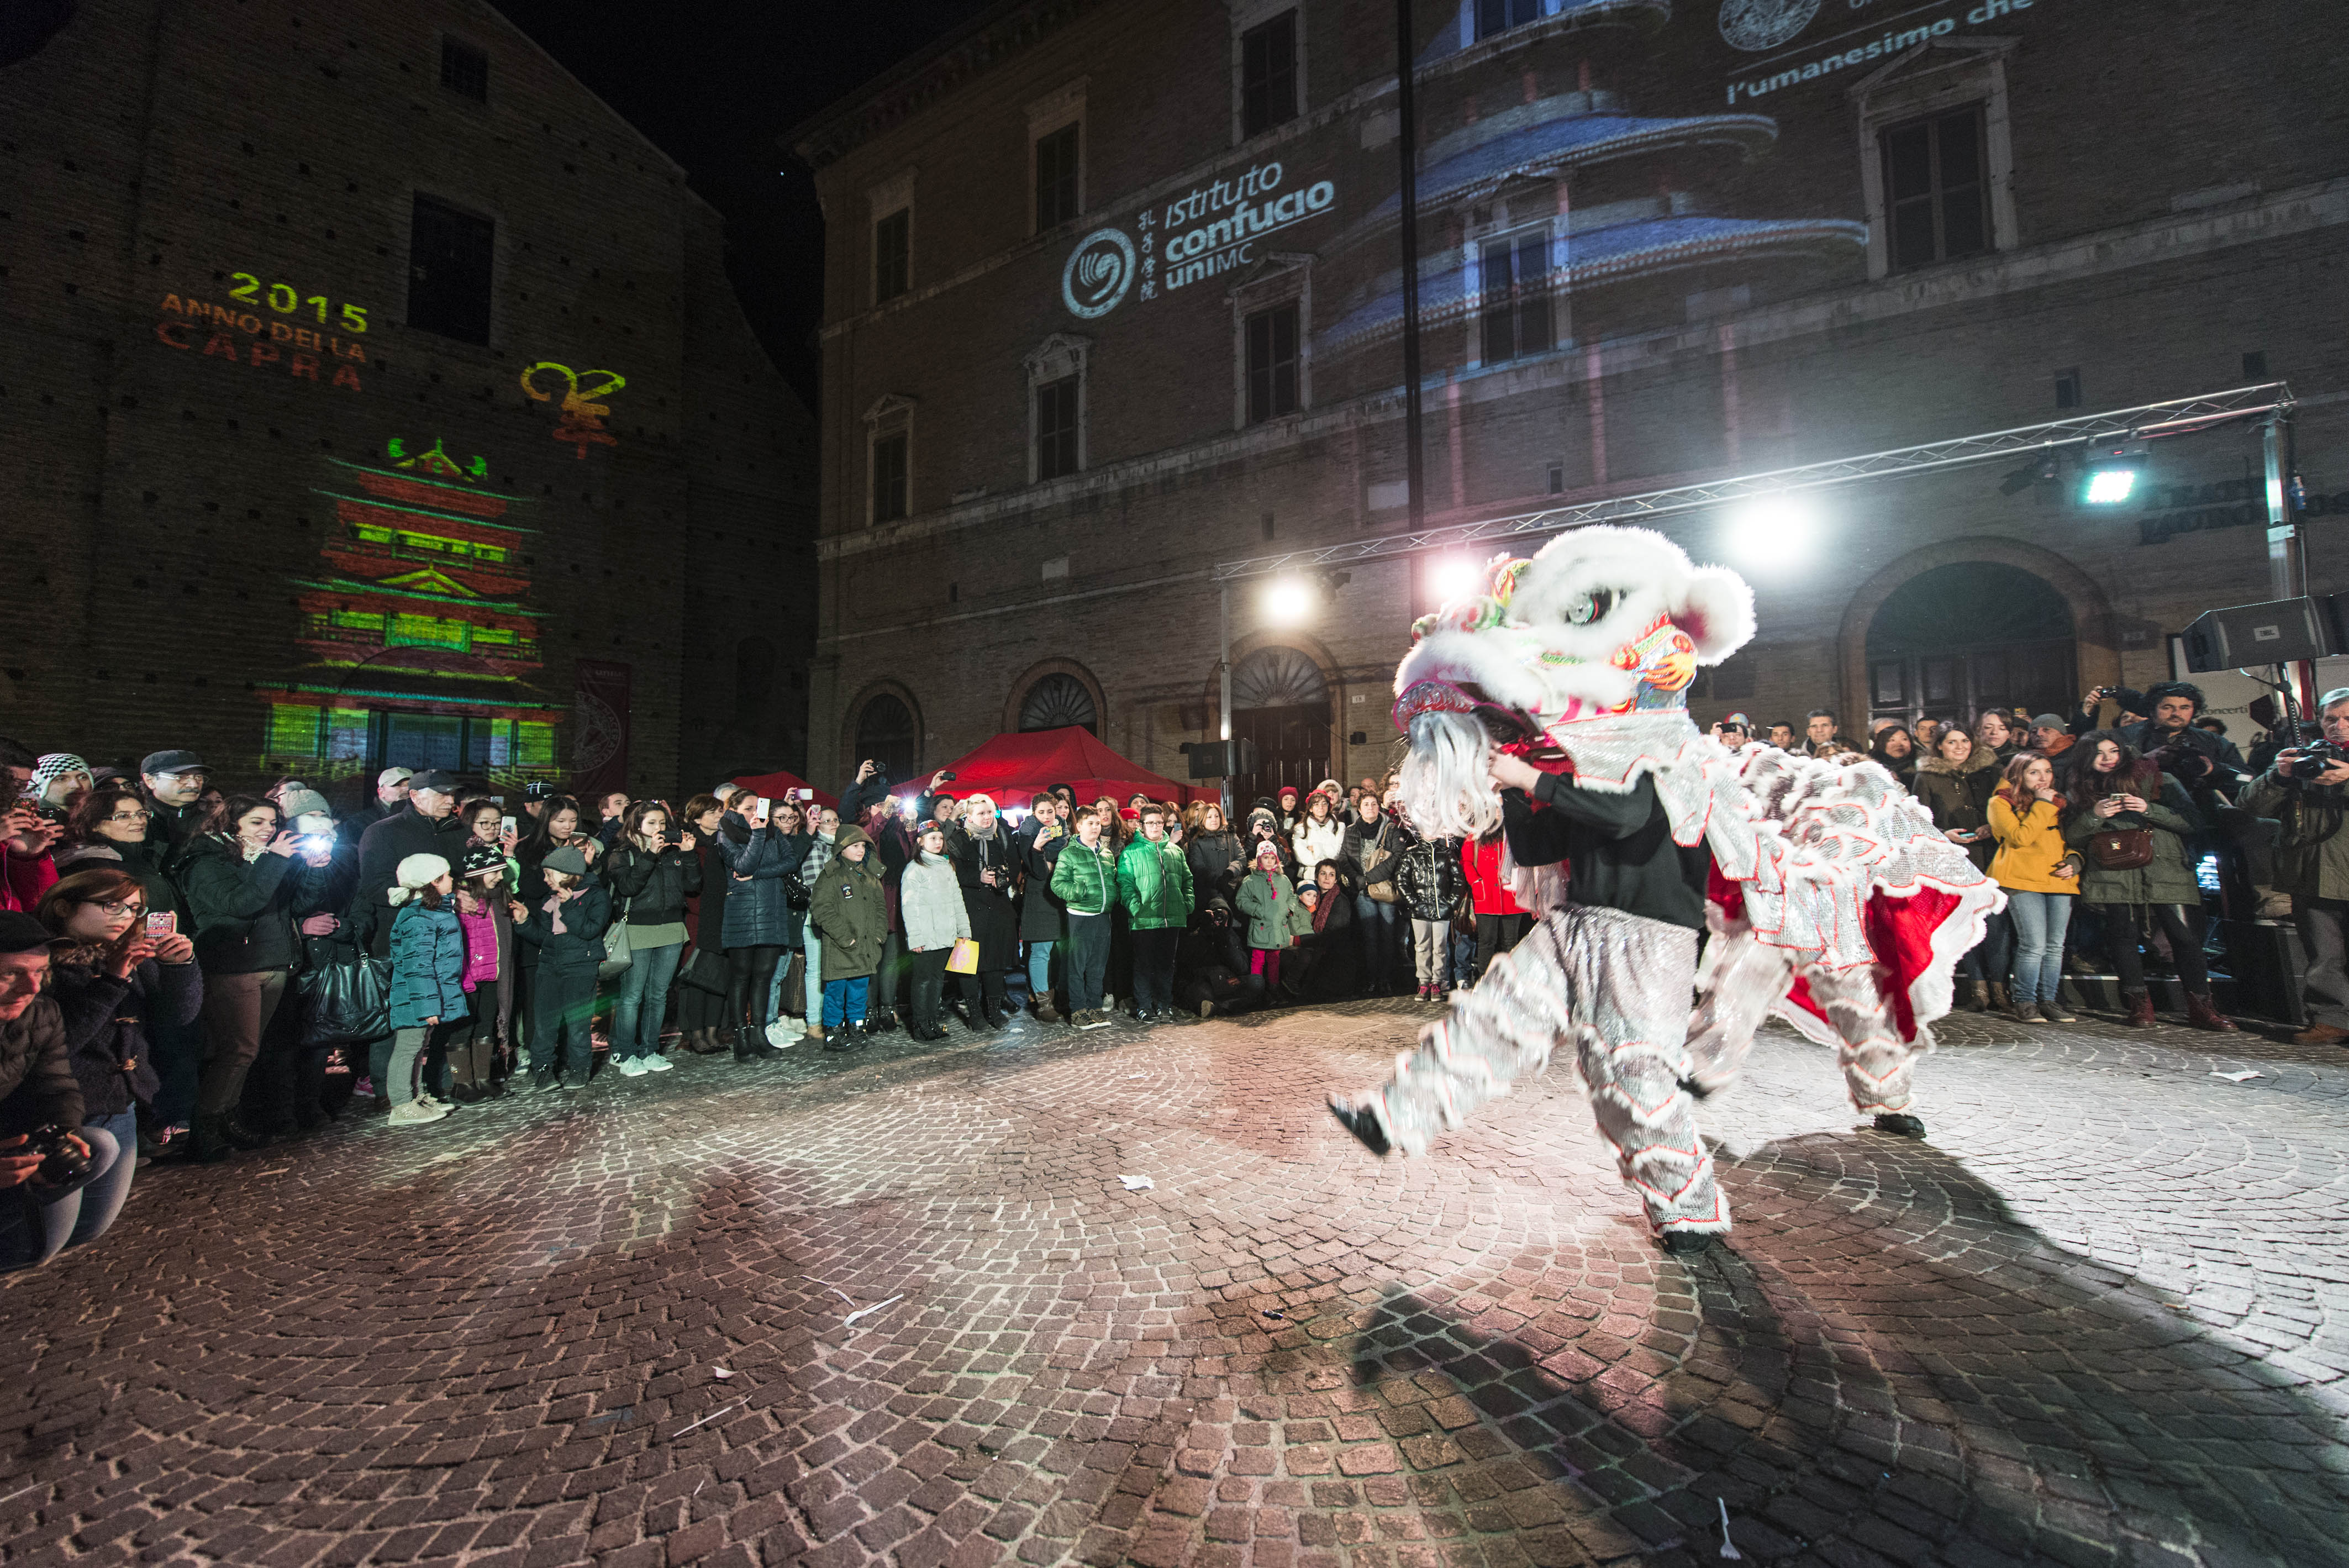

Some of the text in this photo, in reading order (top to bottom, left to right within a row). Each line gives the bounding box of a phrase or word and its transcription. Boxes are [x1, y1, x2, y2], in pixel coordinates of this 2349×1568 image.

[1165, 180, 1335, 262] confucio
[161, 292, 367, 364] ANNO DELLA
[228, 271, 369, 334] 2015
[156, 321, 362, 393] CAPRA
